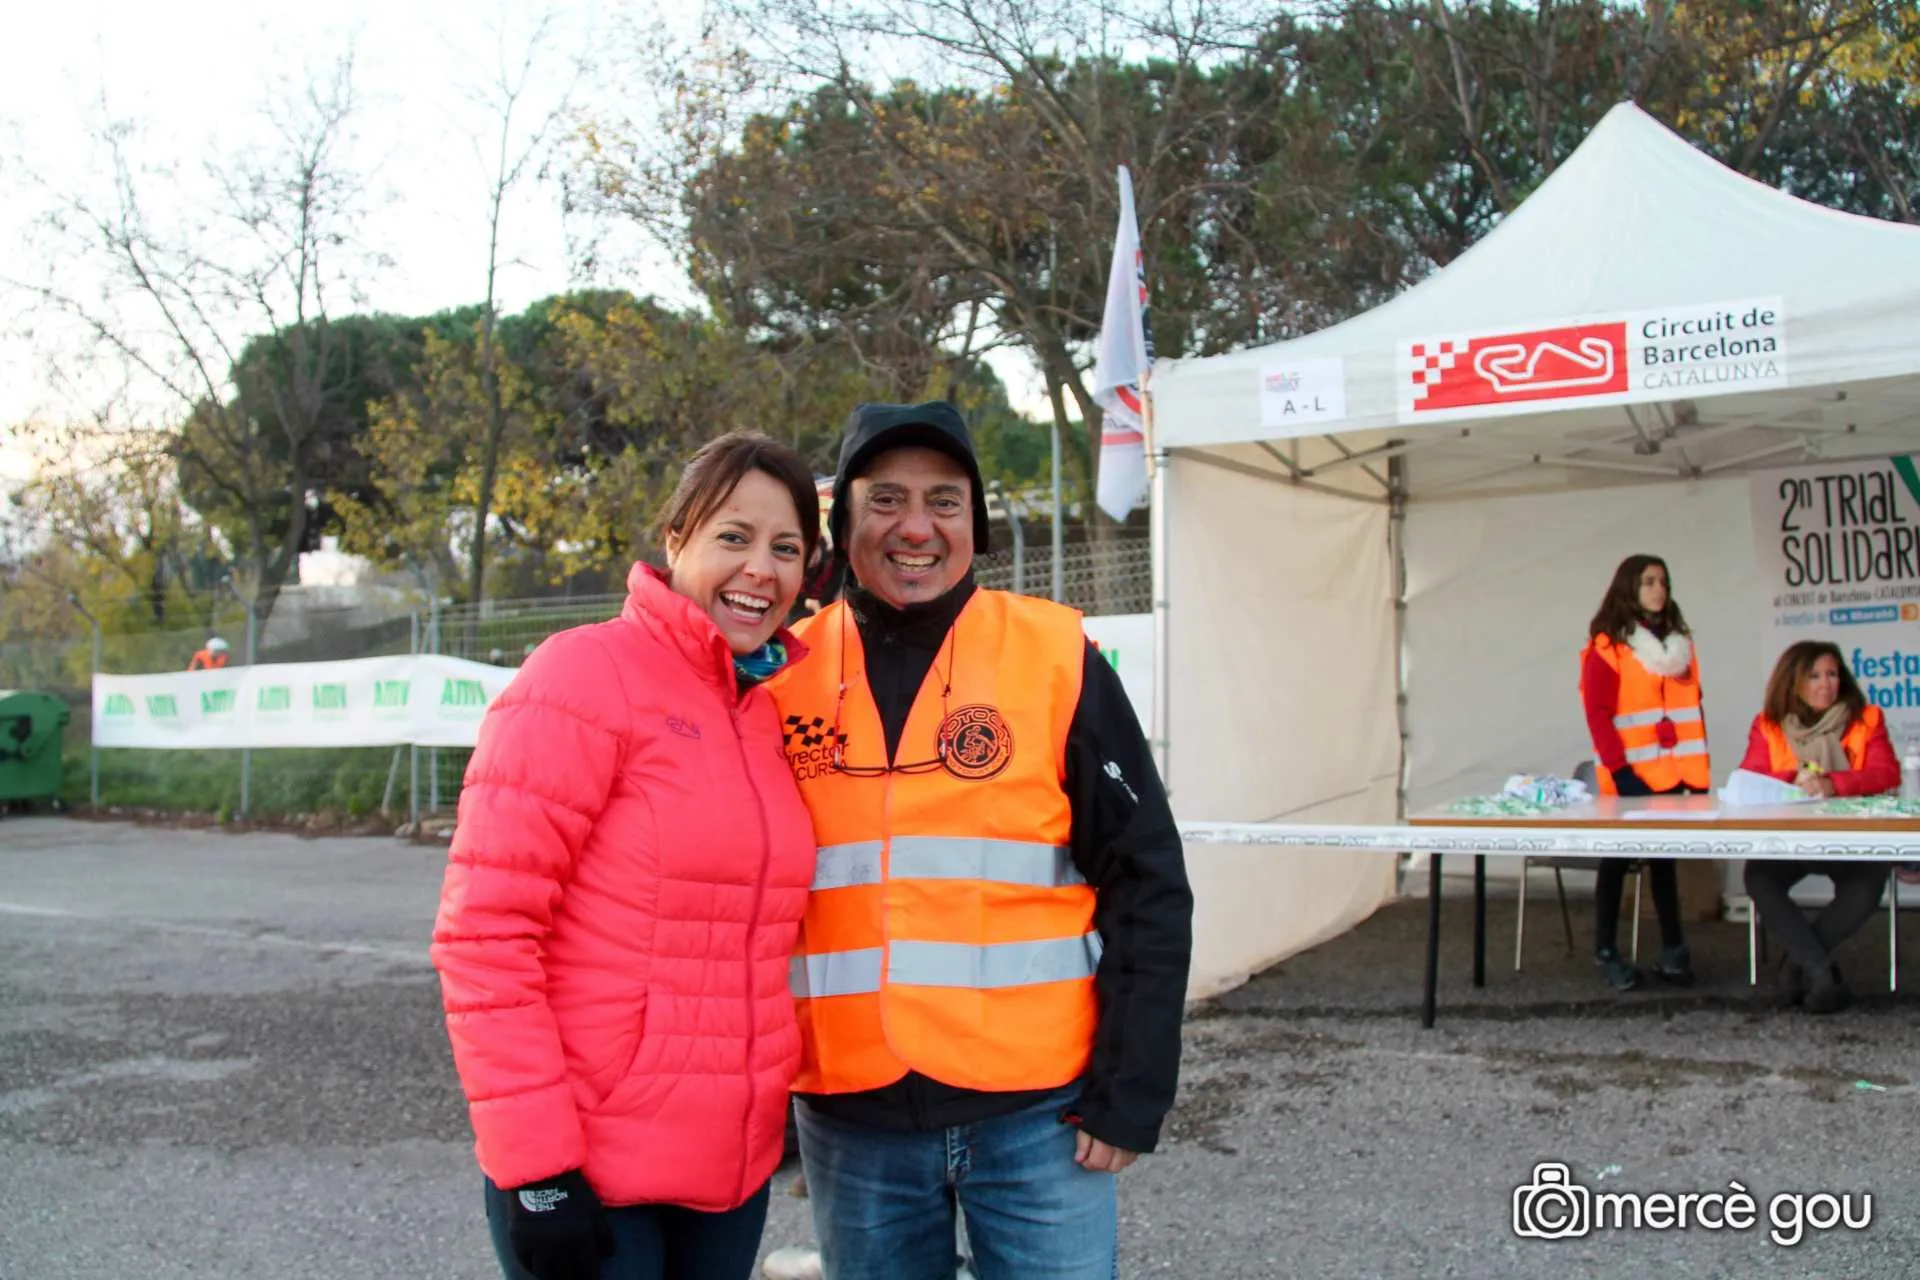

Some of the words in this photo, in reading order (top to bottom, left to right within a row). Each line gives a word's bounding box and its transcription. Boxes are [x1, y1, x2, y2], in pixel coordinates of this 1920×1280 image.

[1643, 312, 1735, 339] Circuit
[1742, 308, 1775, 328] de
[1644, 337, 1777, 366] Barcelona
[1644, 360, 1780, 390] CATALUNYA
[1282, 399, 1297, 416] A
[1314, 396, 1327, 412] L
[1852, 647, 1920, 679] festa
